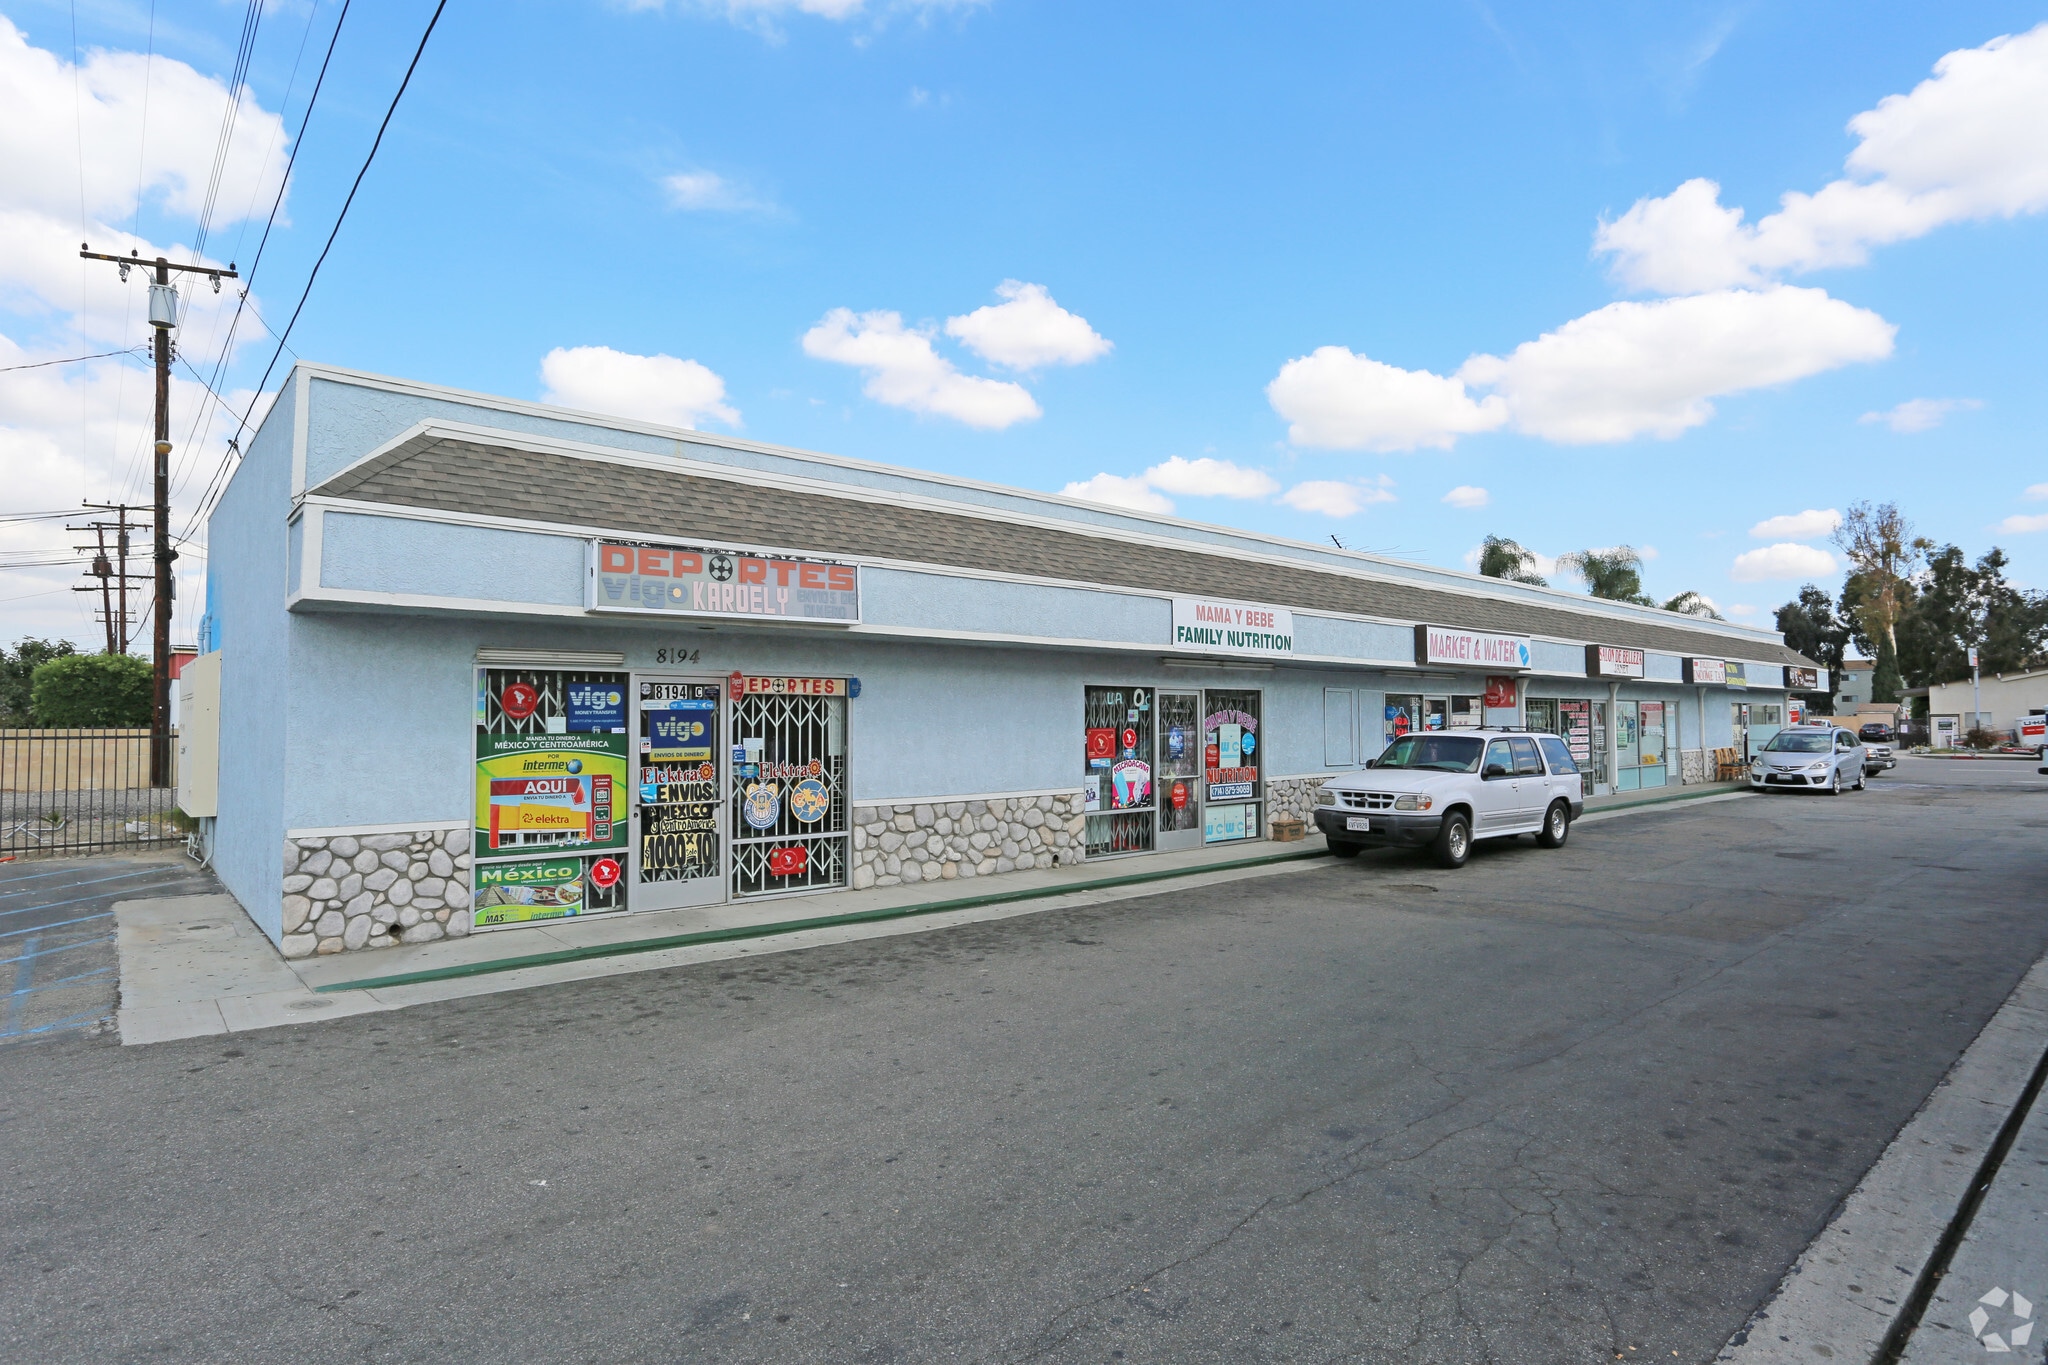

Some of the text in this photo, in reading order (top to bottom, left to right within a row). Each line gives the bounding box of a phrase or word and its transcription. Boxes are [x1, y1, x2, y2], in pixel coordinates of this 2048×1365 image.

[602, 574, 688, 609] vigo
[1195, 604, 1275, 629] MAMA Y BEBE
[1177, 625, 1292, 651] FAMILY NUTRITION
[1429, 632, 1516, 663] MARKET & WATER
[1599, 647, 1643, 665] SALON DE BELLEZA
[656, 648, 701, 665] 8194
[1693, 670, 1713, 681] INCOME
[656, 685, 687, 699] 8194
[696, 687, 702, 697] C
[744, 677, 835, 694] EPORTES
[569, 686, 622, 710] vigo
[656, 716, 704, 742] vigo
[1205, 709, 1258, 734] MAMA Y BEBE
[494, 739, 609, 749] MÉXICO Y CENTROAMÉRICA
[641, 764, 700, 785] Elektra
[758, 761, 808, 779] Elektra
[1113, 760, 1149, 775] MICHOACANA
[1206, 766, 1257, 784] NUTRITION
[524, 777, 567, 794] AQUÍ
[656, 781, 715, 803] ENVIOS
[814, 792, 827, 807] A
[535, 812, 570, 824] elektra
[660, 804, 713, 820] MEXICO
[481, 866, 573, 883] México
[484, 913, 505, 923] MAS
